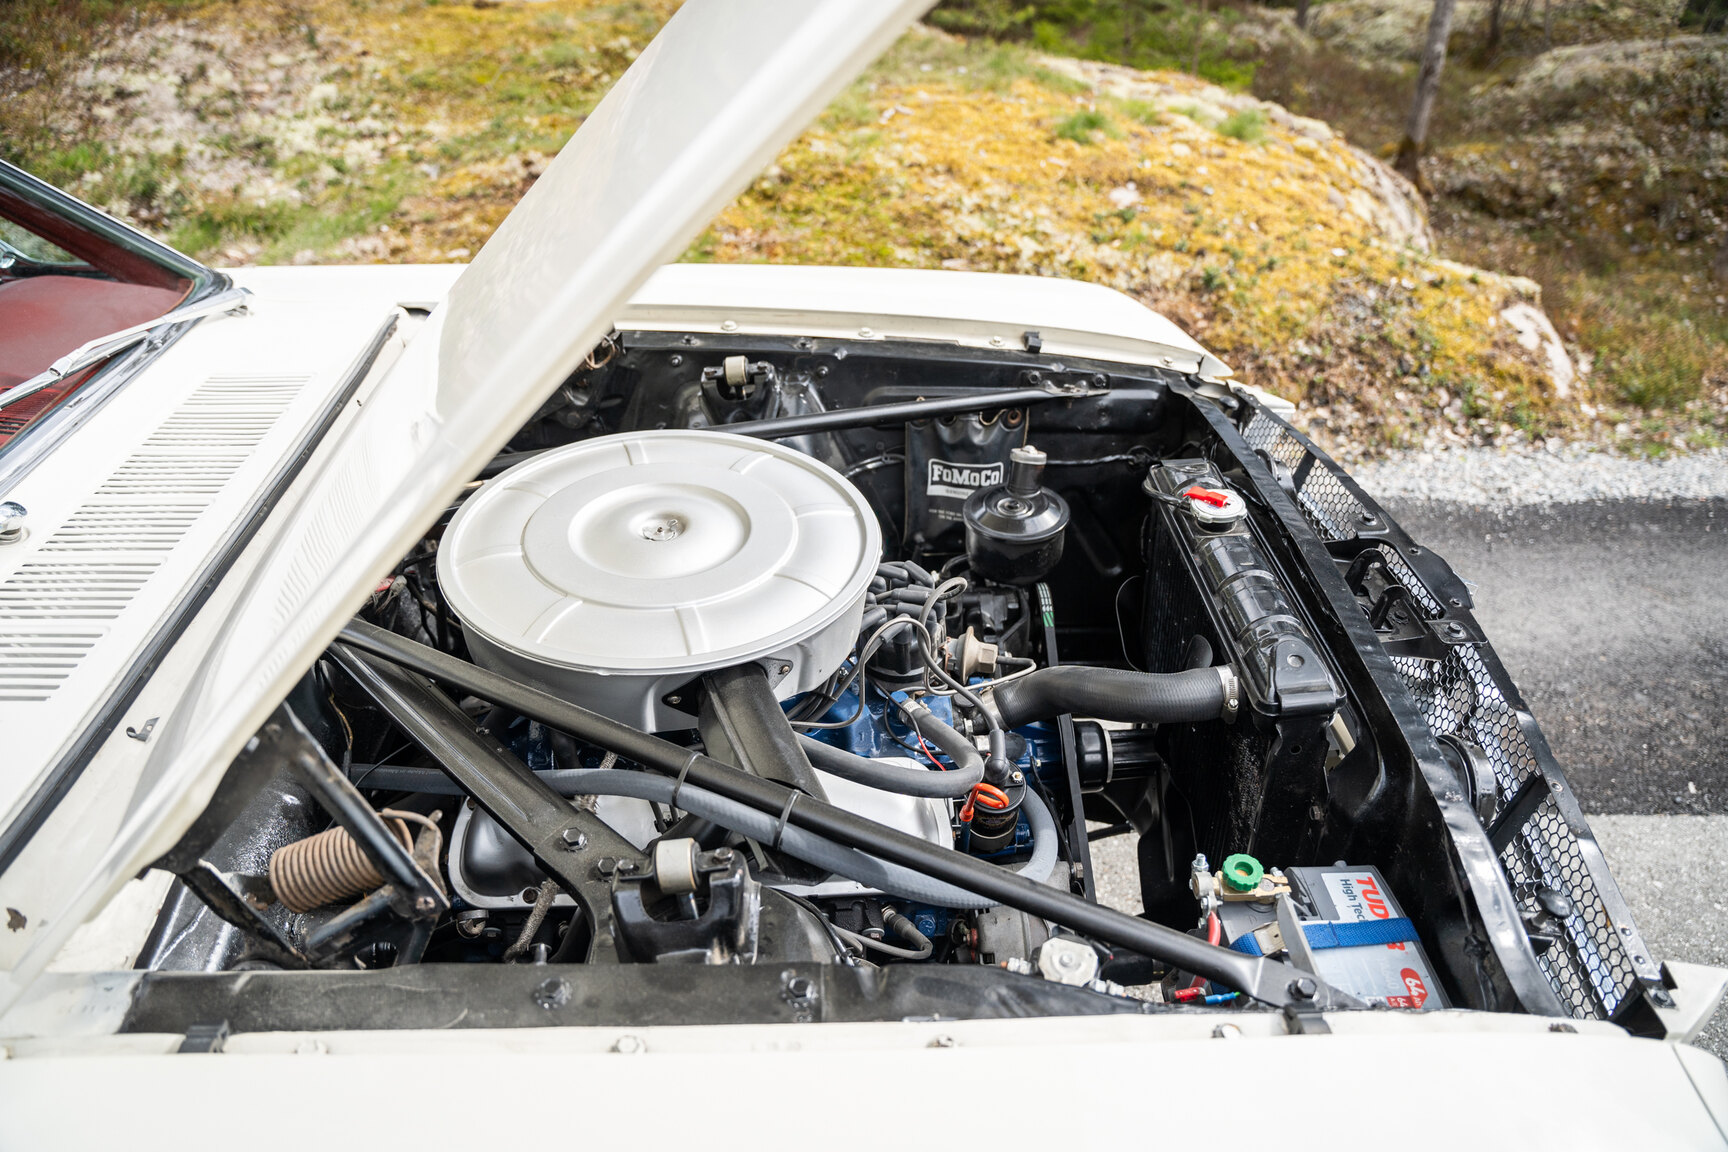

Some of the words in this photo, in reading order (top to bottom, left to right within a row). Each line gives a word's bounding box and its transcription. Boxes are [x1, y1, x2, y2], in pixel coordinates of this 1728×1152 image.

[932, 464, 1000, 487] FoMoCo
[1340, 879, 1357, 901] High
[1351, 902, 1368, 922] Tec
